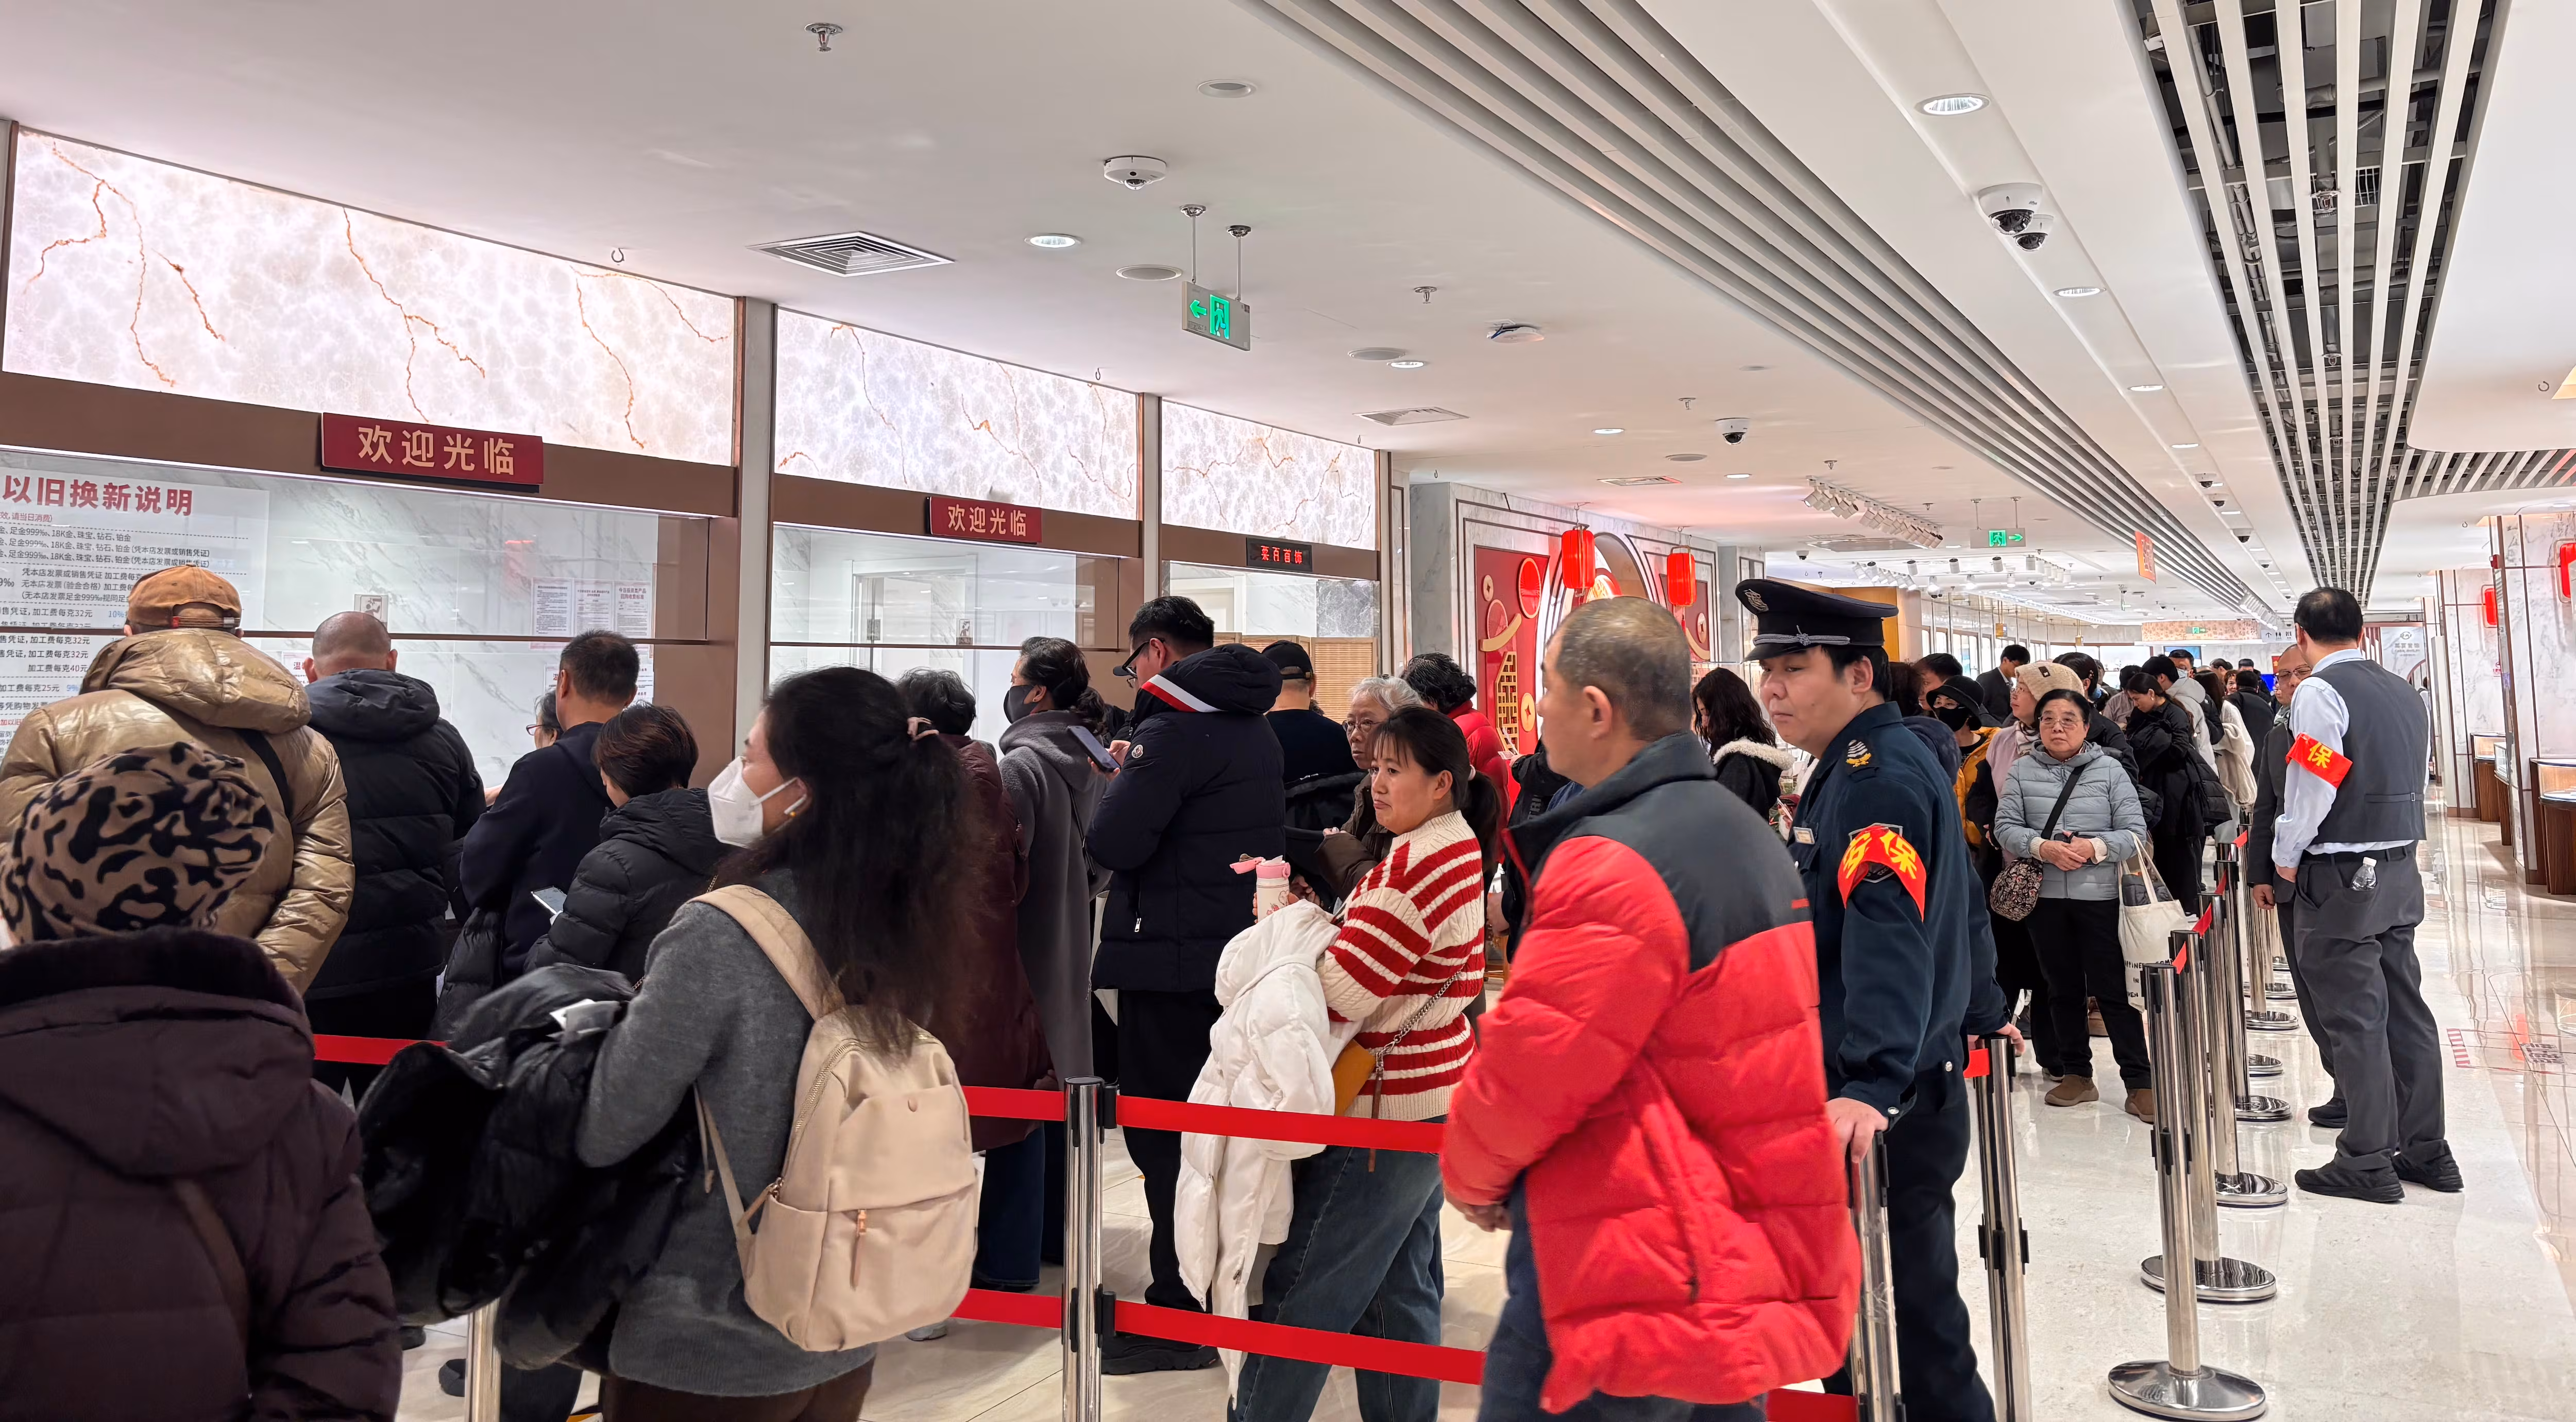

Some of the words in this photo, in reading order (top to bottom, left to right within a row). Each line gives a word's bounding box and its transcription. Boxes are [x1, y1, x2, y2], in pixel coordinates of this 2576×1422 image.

[358, 425, 515, 476] 欢迎光临
[2, 474, 193, 516] 以旧换新说明
[947, 504, 1027, 537] 欢迎光临
[1261, 545, 1302, 564] 菜百首饰
[22, 568, 103, 579] 凭本店发票或销售凭证
[0, 607, 93, 618] 售凭证,加工费每克32元
[2307, 741, 2333, 769] 保
[1843, 830, 1917, 879] 安保
